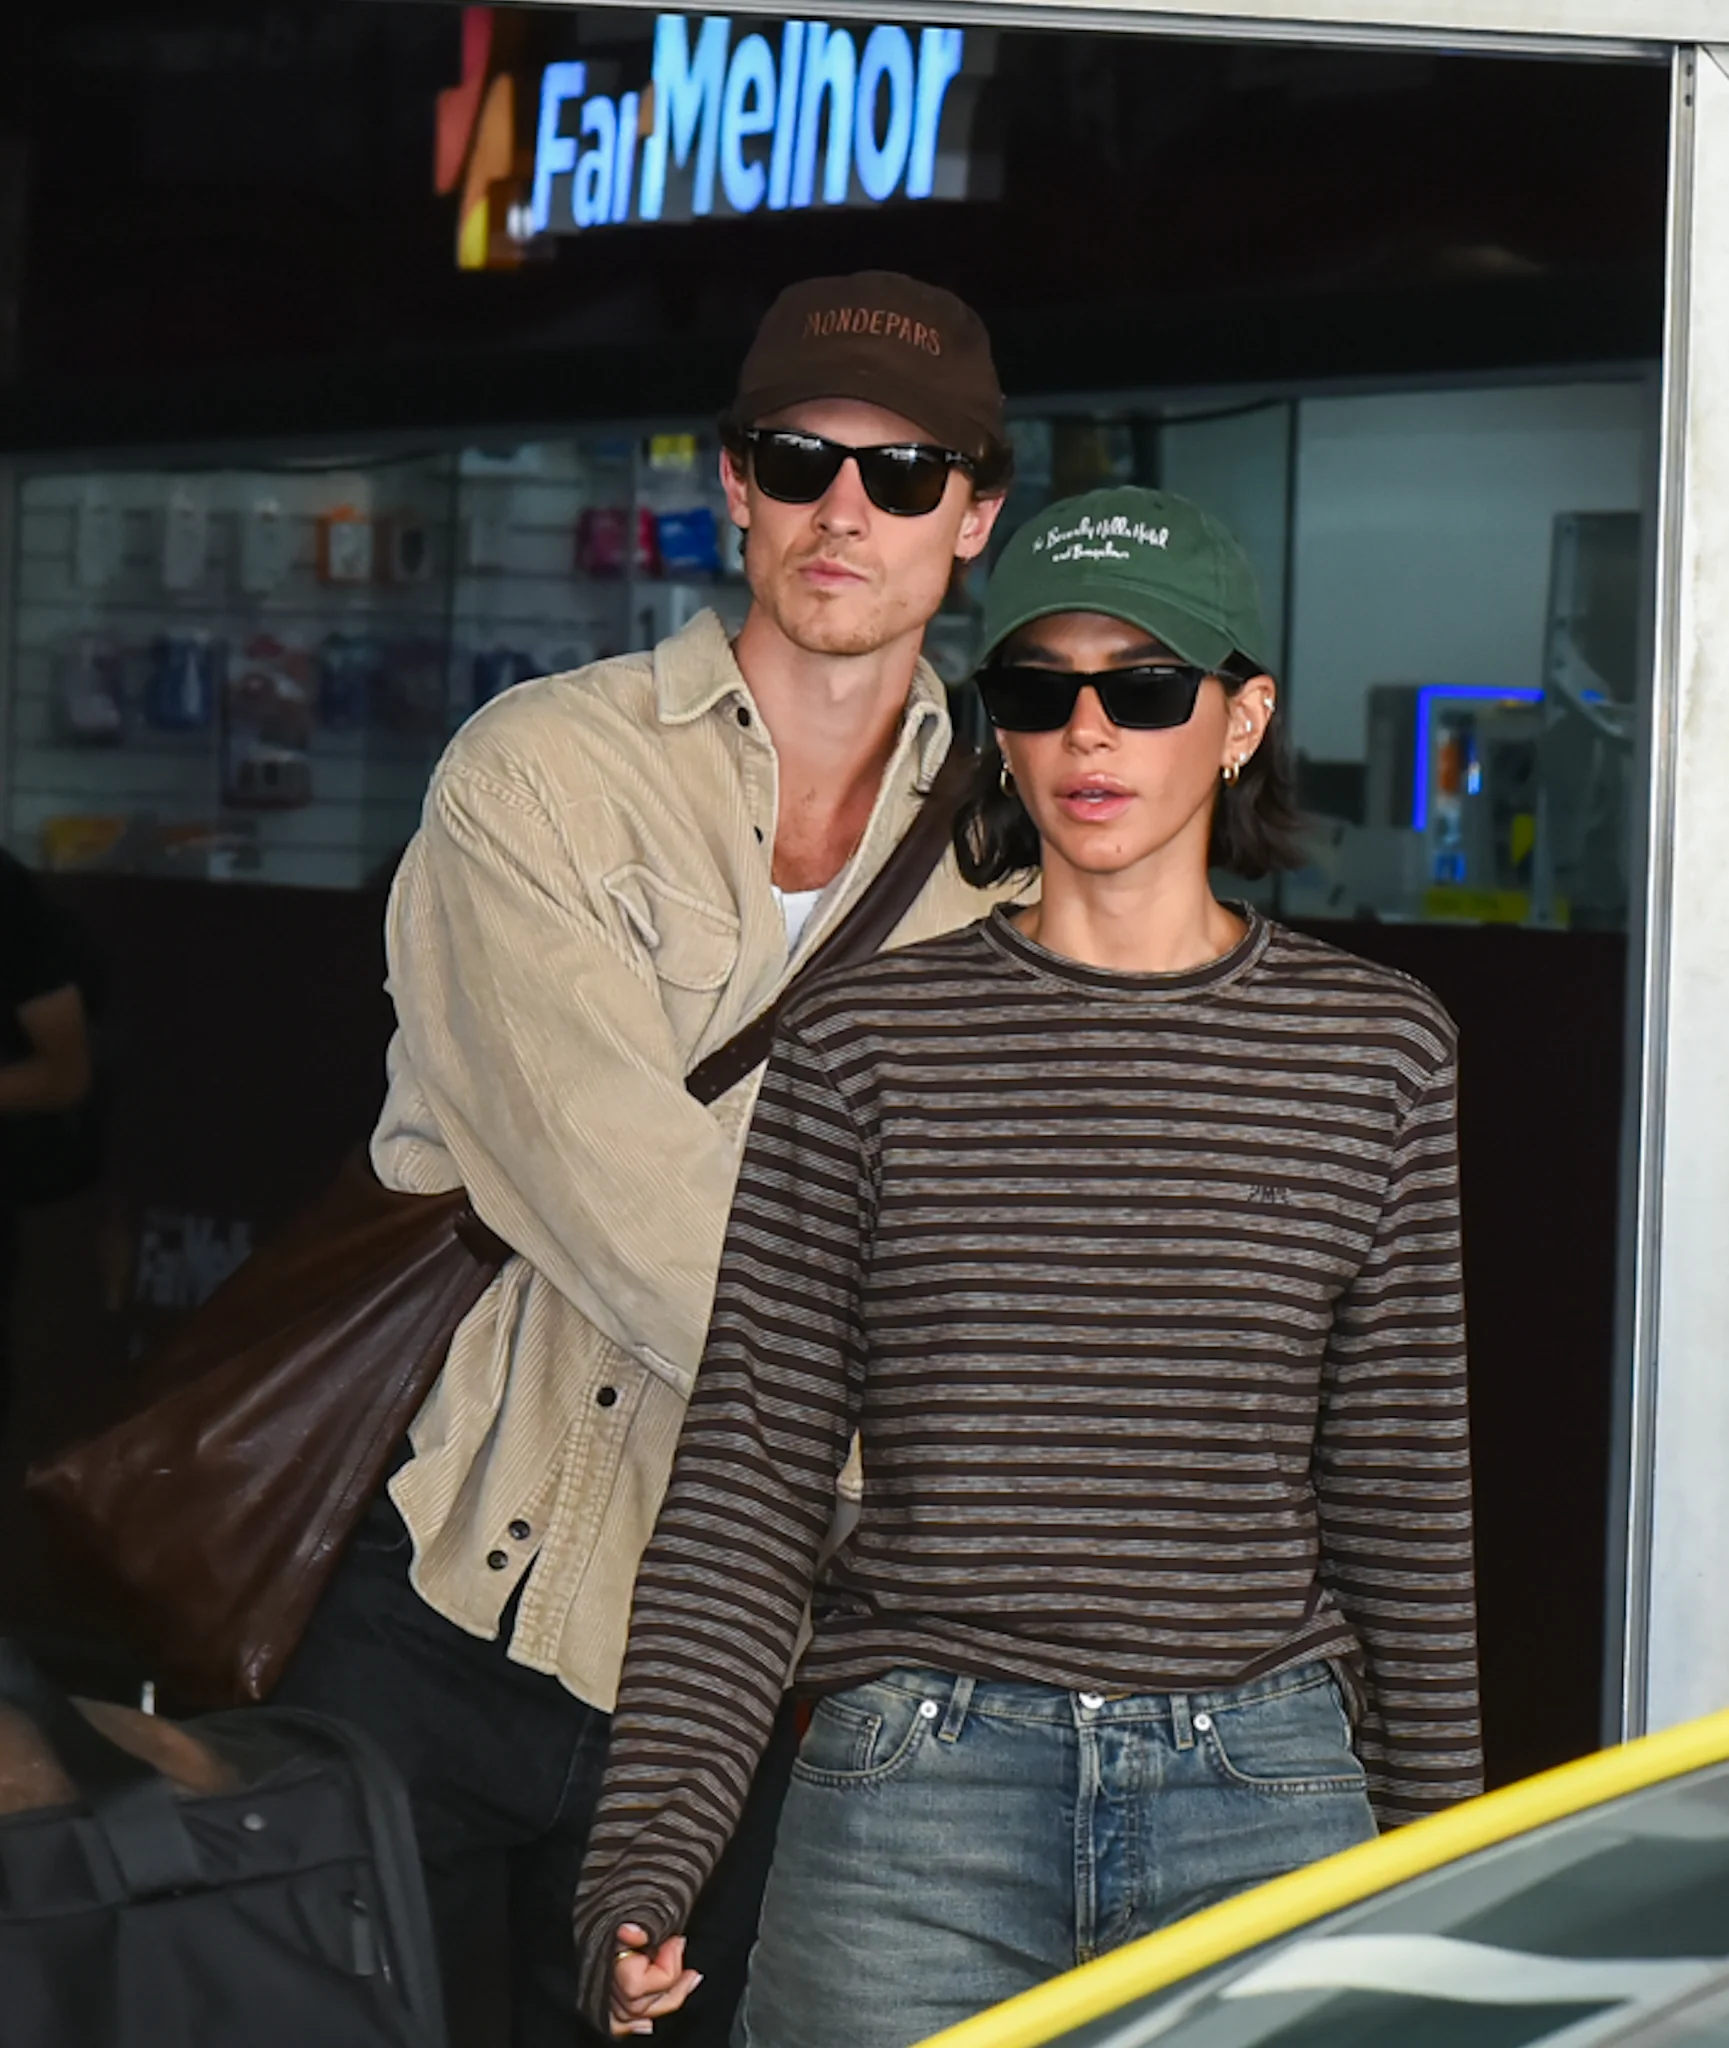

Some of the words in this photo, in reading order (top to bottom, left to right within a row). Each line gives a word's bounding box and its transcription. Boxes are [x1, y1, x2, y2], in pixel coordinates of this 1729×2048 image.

[803, 307, 941, 356] MONDEPARS
[1096, 516, 1131, 540] Hills
[1133, 522, 1169, 549] Hotel
